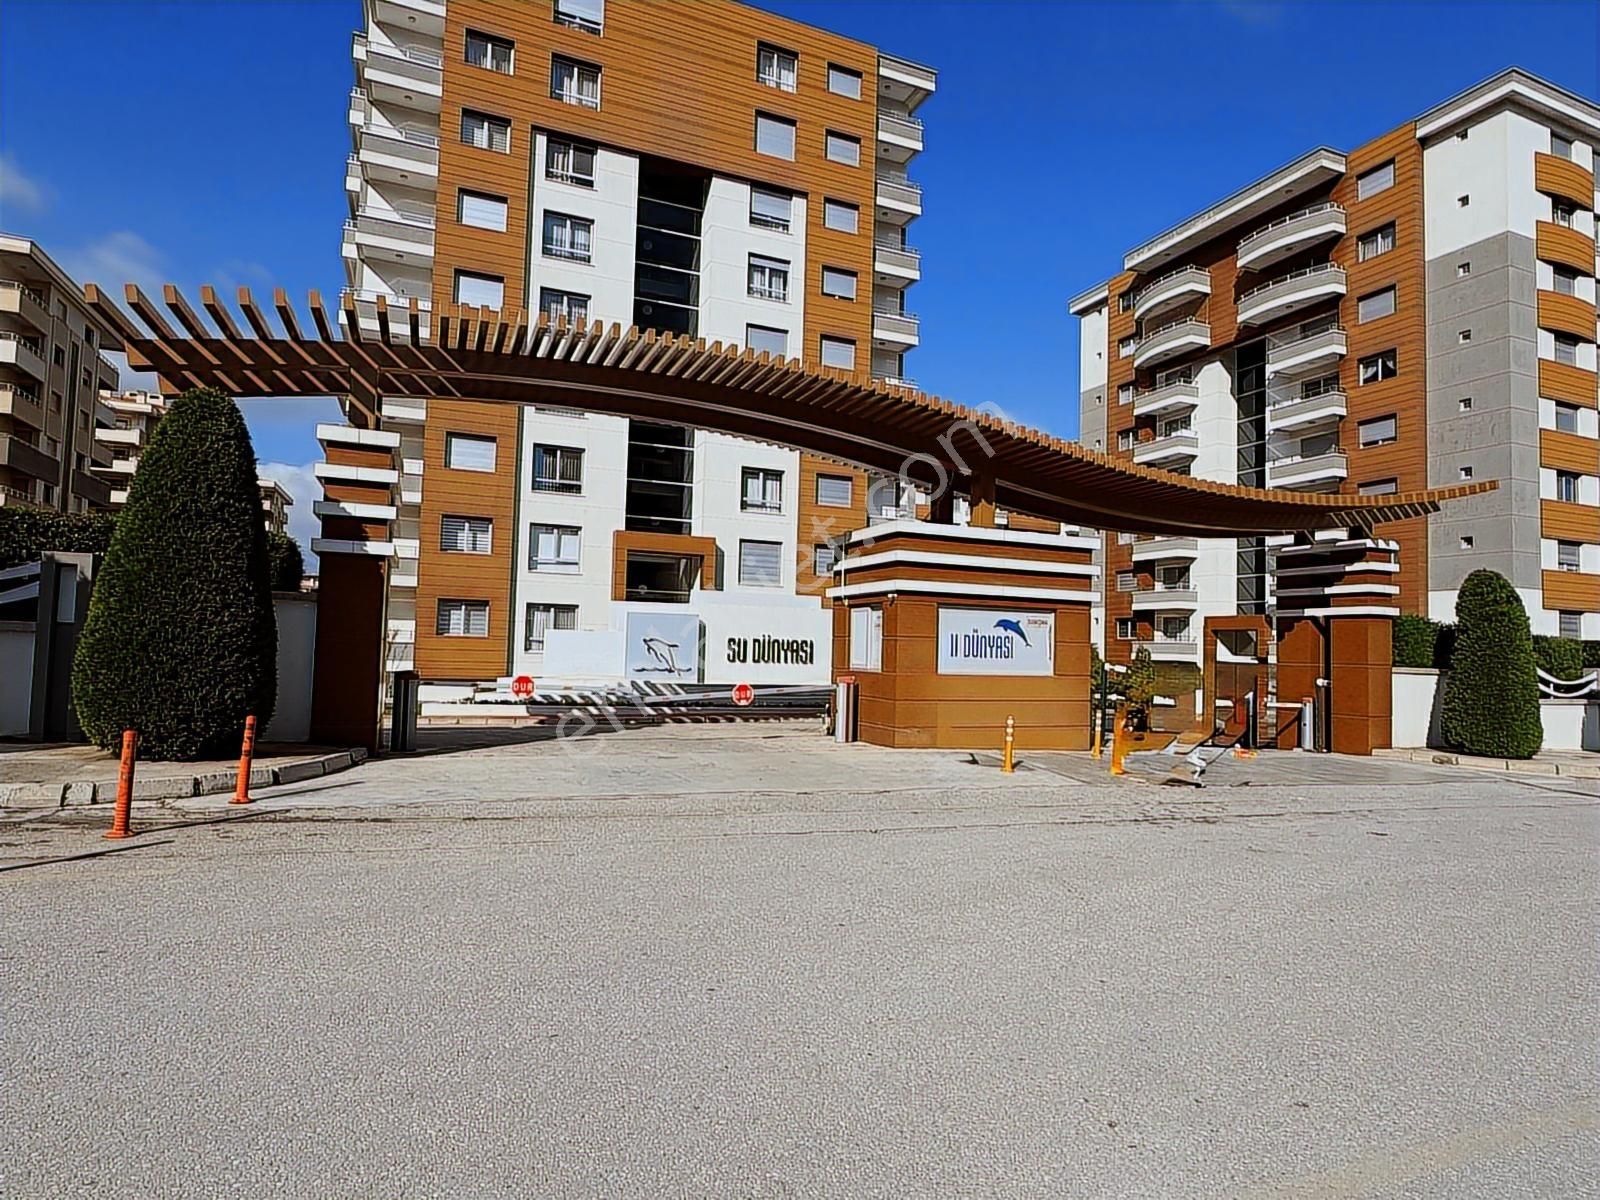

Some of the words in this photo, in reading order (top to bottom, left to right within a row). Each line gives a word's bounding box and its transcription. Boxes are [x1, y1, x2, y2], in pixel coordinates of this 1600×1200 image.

[727, 637, 748, 664] SU
[752, 633, 814, 665] DÜNYASI
[963, 628, 1014, 660] DÜNYASI
